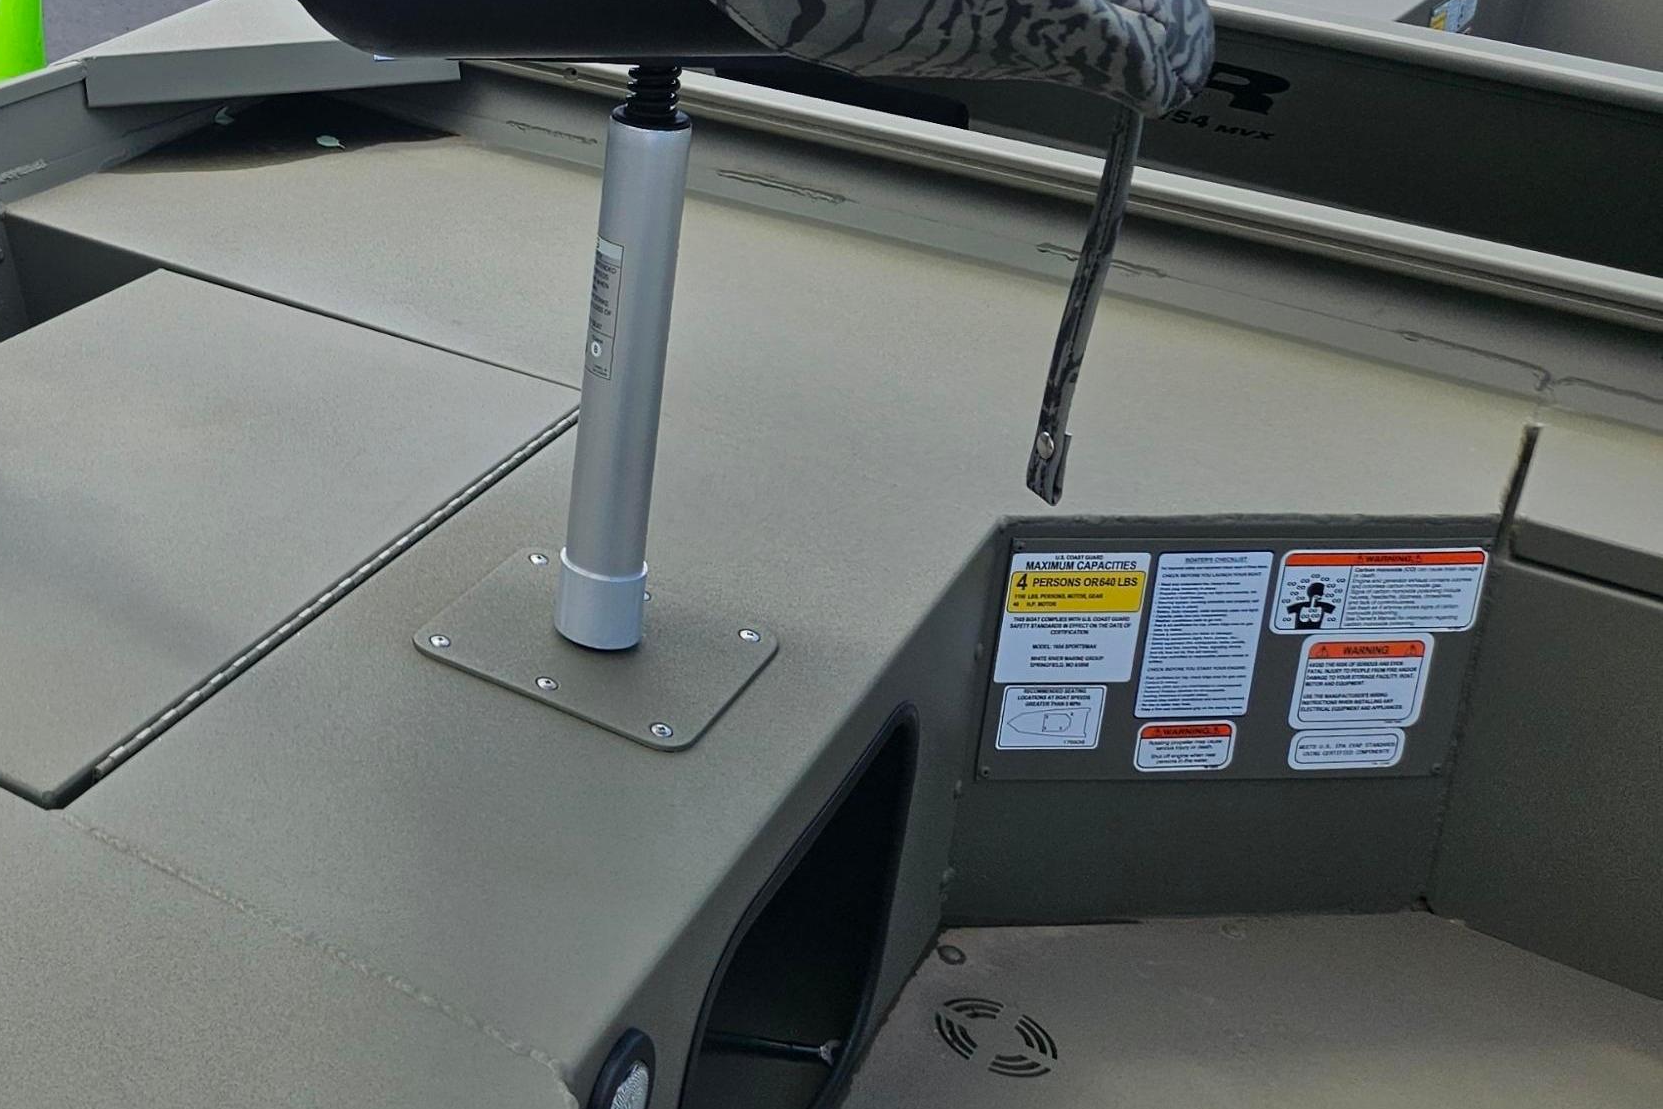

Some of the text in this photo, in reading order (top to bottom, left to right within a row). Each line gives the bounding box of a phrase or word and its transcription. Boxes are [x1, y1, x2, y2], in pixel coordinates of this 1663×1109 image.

[1214, 125, 1274, 140] MVX
[1026, 561, 1136, 570] MAXIMUM CAPACITIES
[1017, 574, 1138, 590] 4 PERSONS OR 640 LBS
[1344, 646, 1389, 655] WARNING
